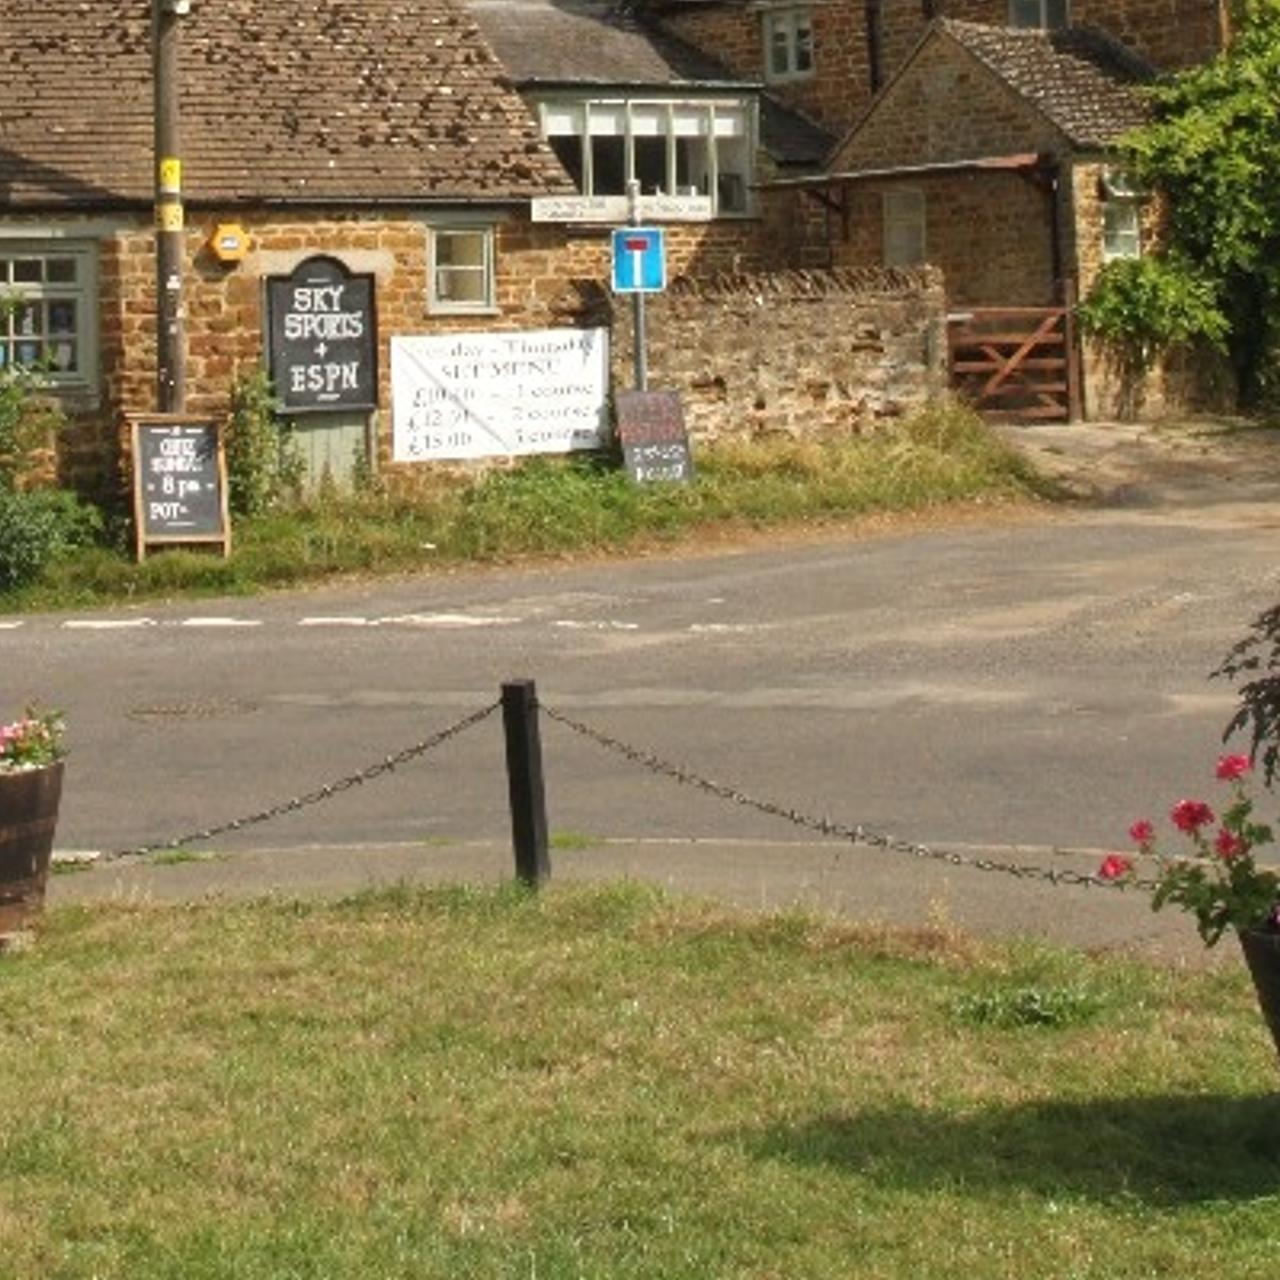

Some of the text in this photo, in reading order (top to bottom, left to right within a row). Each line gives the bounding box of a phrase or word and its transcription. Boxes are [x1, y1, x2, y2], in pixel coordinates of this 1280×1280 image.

[293, 285, 344, 312] SKY
[284, 311, 363, 339] SPORTS
[314, 342, 328, 358] +
[290, 362, 359, 392] ESPN
